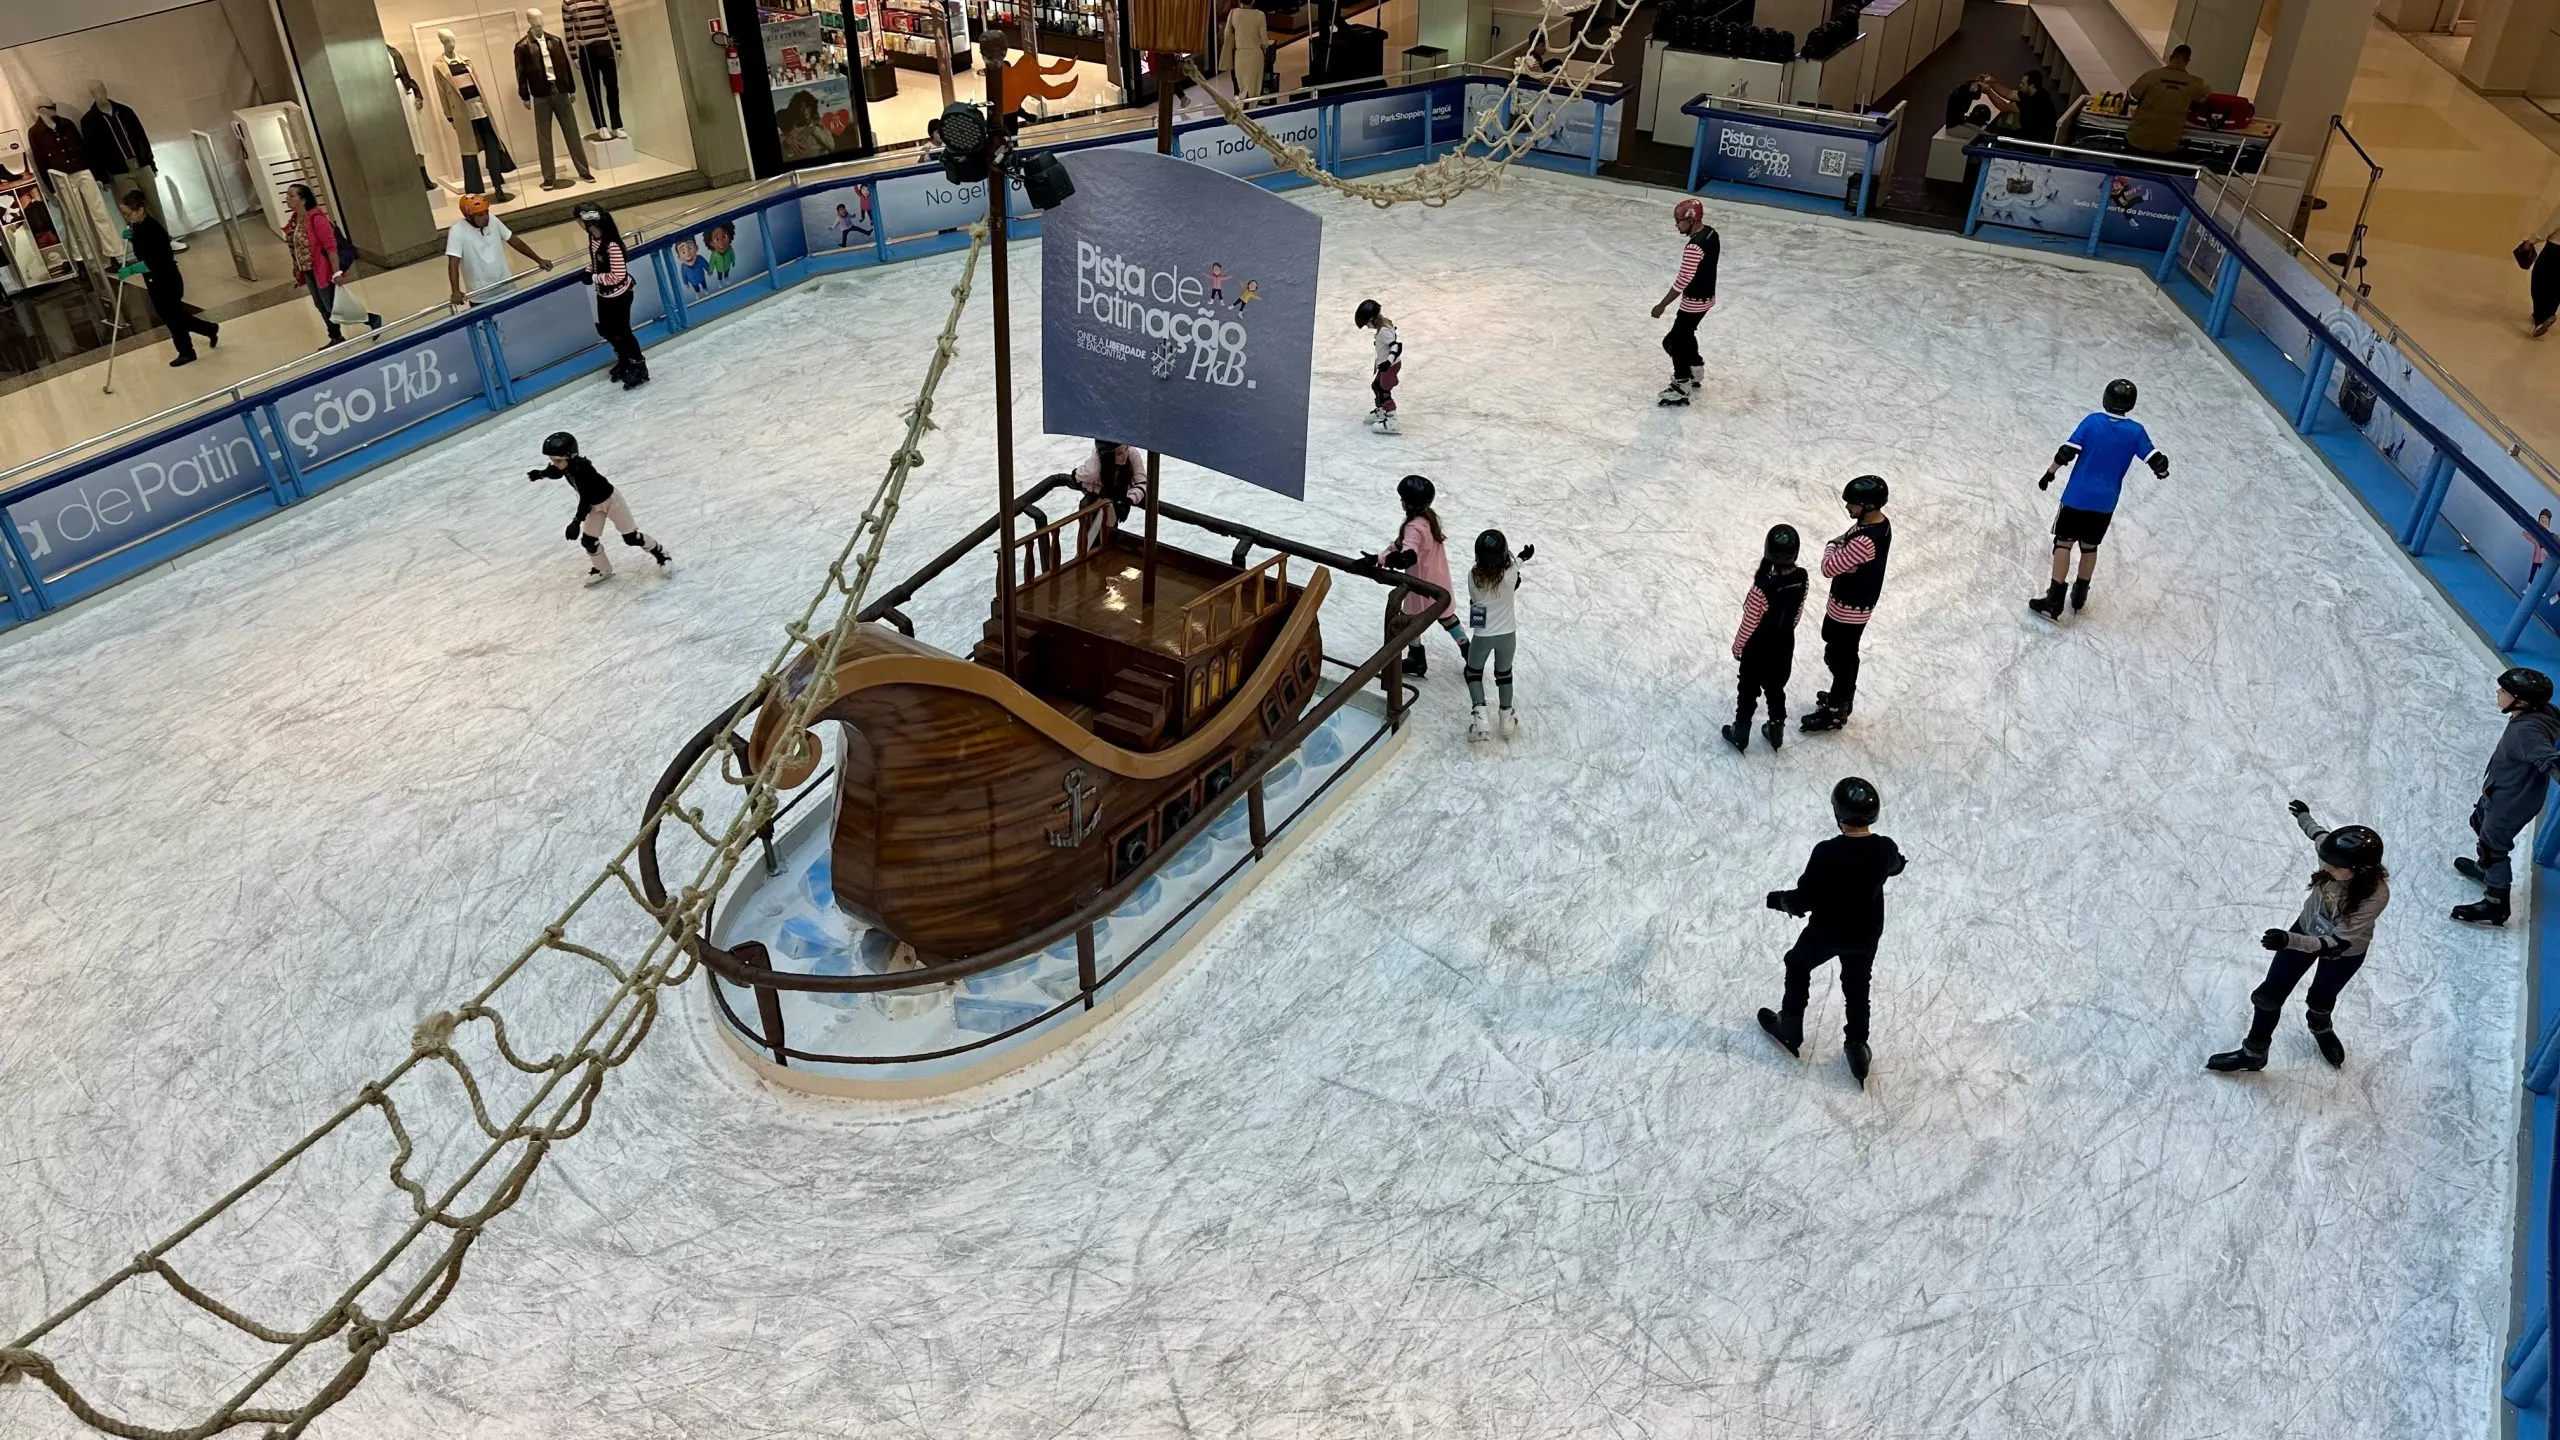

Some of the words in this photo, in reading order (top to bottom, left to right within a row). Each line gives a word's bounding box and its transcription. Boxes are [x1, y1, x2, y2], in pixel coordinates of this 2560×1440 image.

[1720, 128, 1755, 147] Pista
[1756, 133, 1777, 150] de
[1718, 141, 1790, 166] Patinação
[926, 188, 953, 206] No
[2073, 199, 2091, 208] Tudo
[2126, 207, 2137, 215] da
[1077, 240, 1146, 297] Pista
[1151, 265, 1204, 308] de
[1077, 277, 1247, 354] Patinação
[1077, 330, 1098, 344] ONDE
[1098, 337, 1104, 347] A
[1105, 339, 1147, 360] LIBERDADE
[1077, 338, 1085, 349] SE
[1086, 341, 1127, 362] ENCONTRA
[57, 487, 135, 542] de
